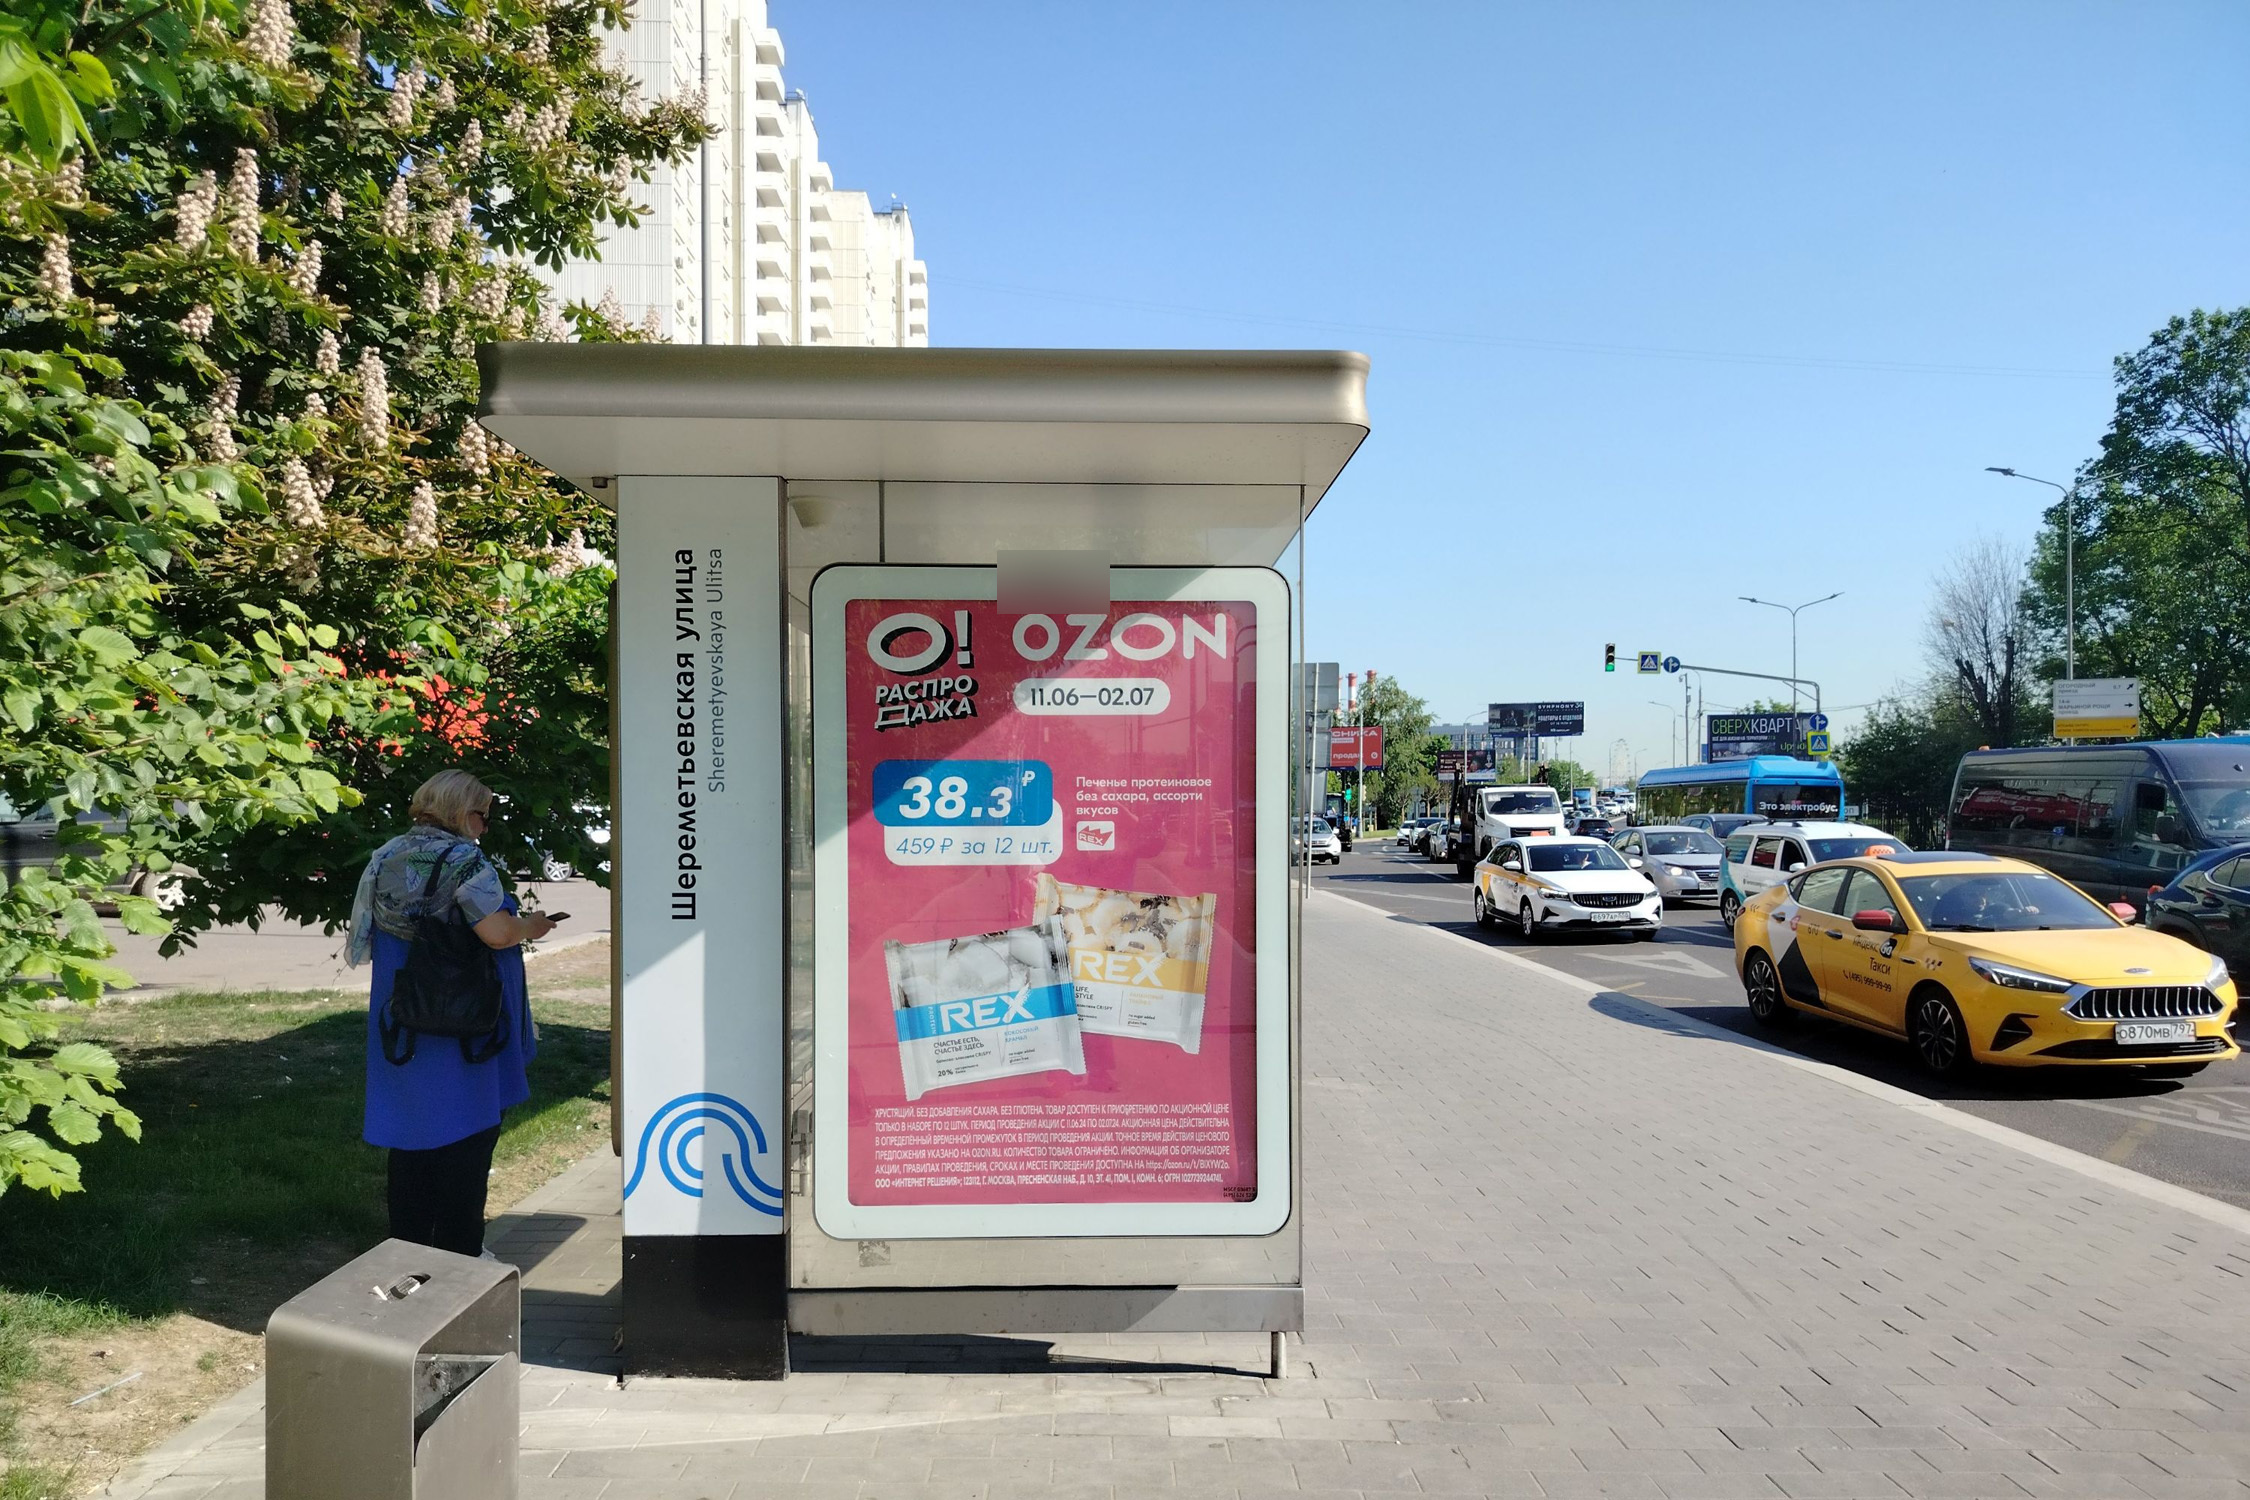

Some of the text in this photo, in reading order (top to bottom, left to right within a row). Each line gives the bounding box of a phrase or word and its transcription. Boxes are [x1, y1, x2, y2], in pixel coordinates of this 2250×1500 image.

[1012, 613, 1227, 661] OZON
[706, 548, 728, 793] Sheremetyevskaya Ulitsa
[876, 675, 977, 704] РАСПРО
[875, 697, 976, 730] ДАЖА
[1712, 717, 1802, 734] СВЕРХКВАРТ
[672, 549, 702, 920] Шереметьевская улица
[1076, 776, 1212, 790] Печенье протеиновое
[1076, 790, 1203, 803] без сахара, ассорти
[1076, 806, 1119, 817] вкусов
[1759, 802, 1777, 810] Это
[1780, 802, 1838, 813] электробус.
[896, 838, 935, 854] 459
[961, 842, 985, 854] за
[995, 837, 1013, 854] 12
[1021, 842, 1053, 854] шт.
[1079, 832, 1103, 845] REX
[1073, 950, 1168, 987] REX
[1869, 957, 1891, 975] Такси
[1864, 976, 1892, 992] 999-99-99
[940, 981, 1035, 1033] REX
[928, 1007, 936, 1034] PROTEIN
[933, 1039, 961, 1049] СЧАСТЬЕ
[934, 1042, 985, 1055] СЧАСТЬЕ ЗДЕСЬ
[938, 1068, 953, 1077] 20%
[916, 1107, 928, 1117] БЕЗ
[929, 1106, 972, 1118] ДОБАВЛЕНИЯ
[1000, 1105, 1012, 1115] БЕЗ
[1045, 1105, 1066, 1115] ТОВАР
[1066, 1104, 1100, 1115] ДОСТУПЕН
[1101, 1104, 1106, 1114] К
[1107, 1104, 1158, 1114] ПРИОБРЕТЕНИЮ
[1159, 1104, 1169, 1114] ПО
[1170, 1102, 1212, 1115] АКЦИОННОЙ
[1213, 1103, 1229, 1115] ЦЕНЕ
[875, 1122, 900, 1132] ТОЛЬКО
[902, 1122, 906, 1131] В
[907, 1121, 931, 1131] НАБОРЕ
[933, 1121, 942, 1131] ПО
[971, 1120, 996, 1130] ПЕРИОД
[997, 1119, 1037, 1130] ПРОВЕДЕНИЯ
[1038, 1119, 1059, 1129] АКЦИИ
[1060, 1119, 1065, 1128] С
[1087, 1119, 1097, 1128] ПО
[1121, 1118, 1160, 1128] АКЦИОННАЯ
[1161, 1118, 1178, 1128] ЦЕНА
[1178, 1117, 1230, 1128] ДЕЙСТВИТЕЛЬНА
[875, 1136, 879, 1146] В
[933, 1133, 971, 1144] ВРЕМЕННОЙ
[972, 1133, 1016, 1143] ПРОМЕЖУТОК
[1018, 1133, 1023, 1143] В
[1024, 1133, 1048, 1143] ПЕРИОД
[1050, 1132, 1090, 1143] ПРОВЕДЕНИЯ
[1115, 1132, 1140, 1141] ТОЧНОЕ
[1142, 1132, 1161, 1141] ВРЕМЯ
[1162, 1131, 1194, 1142] ДЕЙСТВИЯ
[1196, 1132, 1230, 1142] ЦЕНОВОГО
[875, 1150, 926, 1160] ПРЕДЛОЖЕНИЯ
[927, 1149, 959, 1159] УКАЗАНО
[961, 1148, 970, 1158] НА
[1004, 1147, 1047, 1157] КОЛИЧЕСТВО
[1048, 1146, 1073, 1156] ТОВАРА
[1120, 1145, 1169, 1156] ИНФОРМАЦИЯ
[1169, 1145, 1180, 1155] ОБ
[1180, 1145, 1230, 1155] ОРГАНИЗАТОРЕ
[902, 1163, 940, 1173] ПРАВИЛАХ
[989, 1161, 1018, 1171] СРОКАХ
[1019, 1161, 1024, 1170] И
[1025, 1160, 1048, 1170] МЕСТЕ
[1049, 1160, 1094, 1171] ПРОВЕДЕНИЯ
[1095, 1159, 1133, 1170] ДОСТУПНА
[1134, 1159, 1144, 1169] НА
[875, 1178, 890, 1188] ООО
[1017, 1174, 1061, 1185] ПРЕСНЕНСКАЯ
[1164, 1173, 1180, 1183] ОГРН
